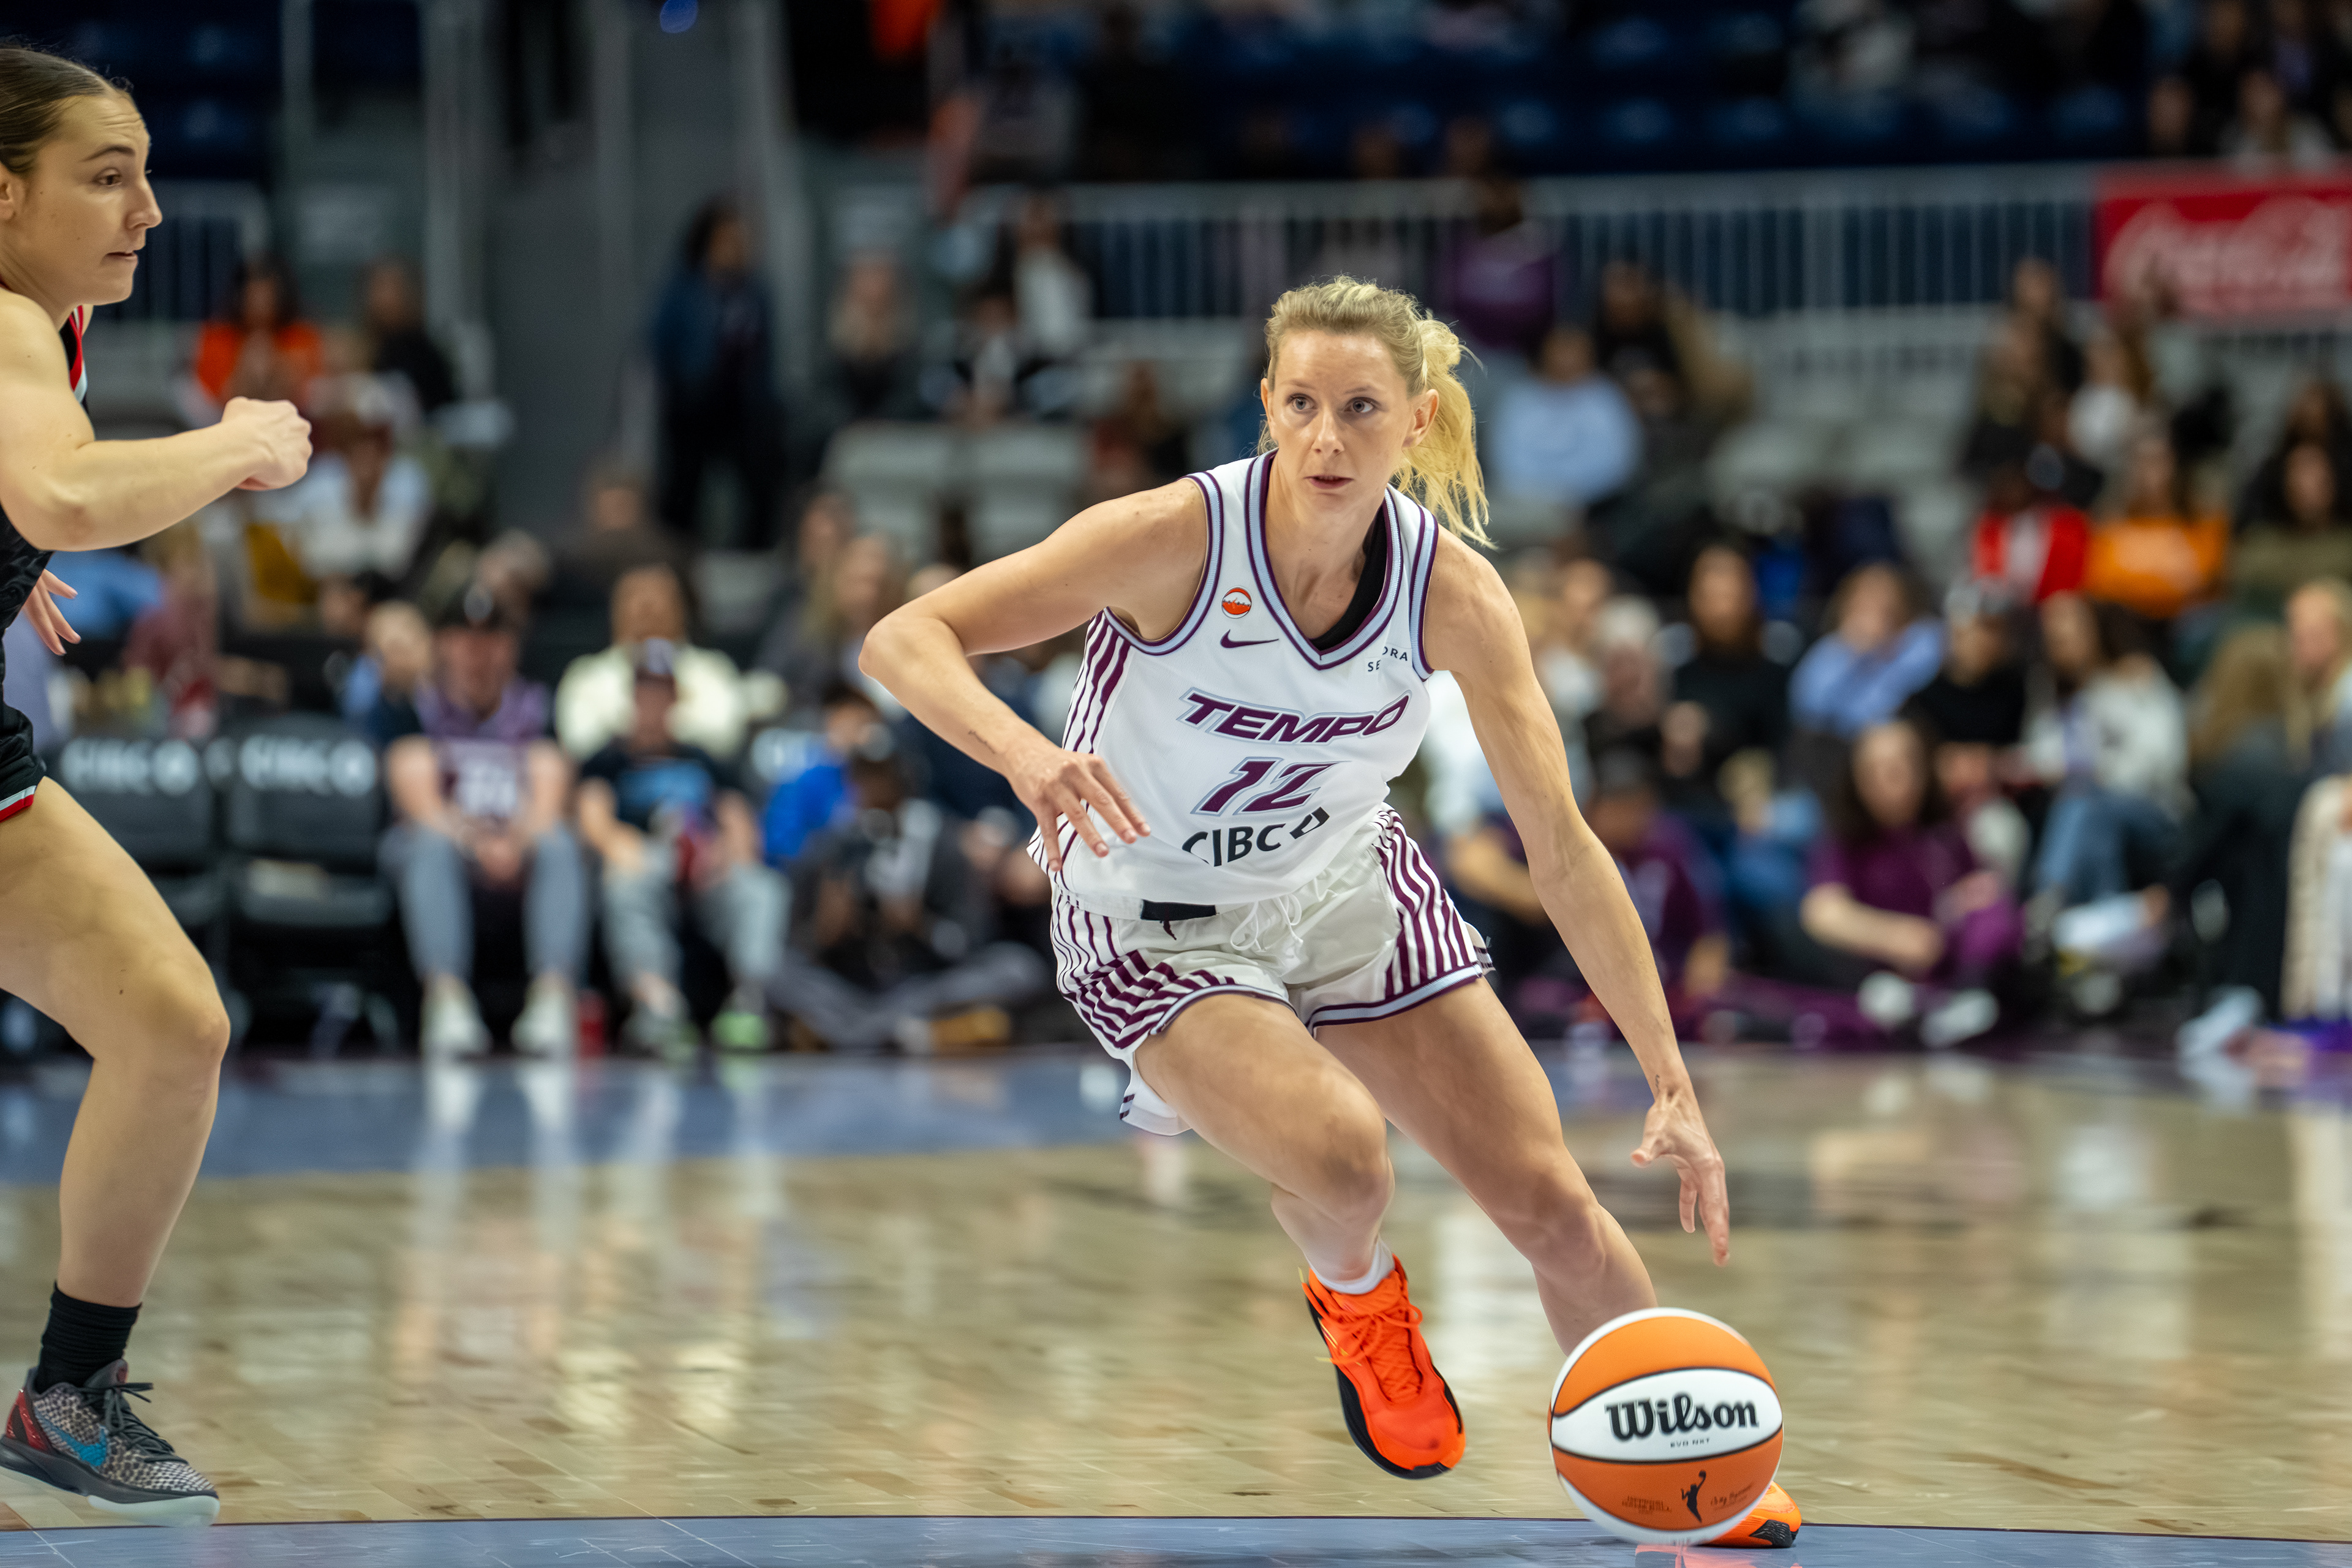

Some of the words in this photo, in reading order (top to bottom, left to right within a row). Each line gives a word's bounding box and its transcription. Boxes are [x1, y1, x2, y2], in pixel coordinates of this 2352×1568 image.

[1178, 688, 1411, 745] TEMPO
[1191, 757, 1345, 816] 12
[1604, 1392, 1759, 1443] Wilson
